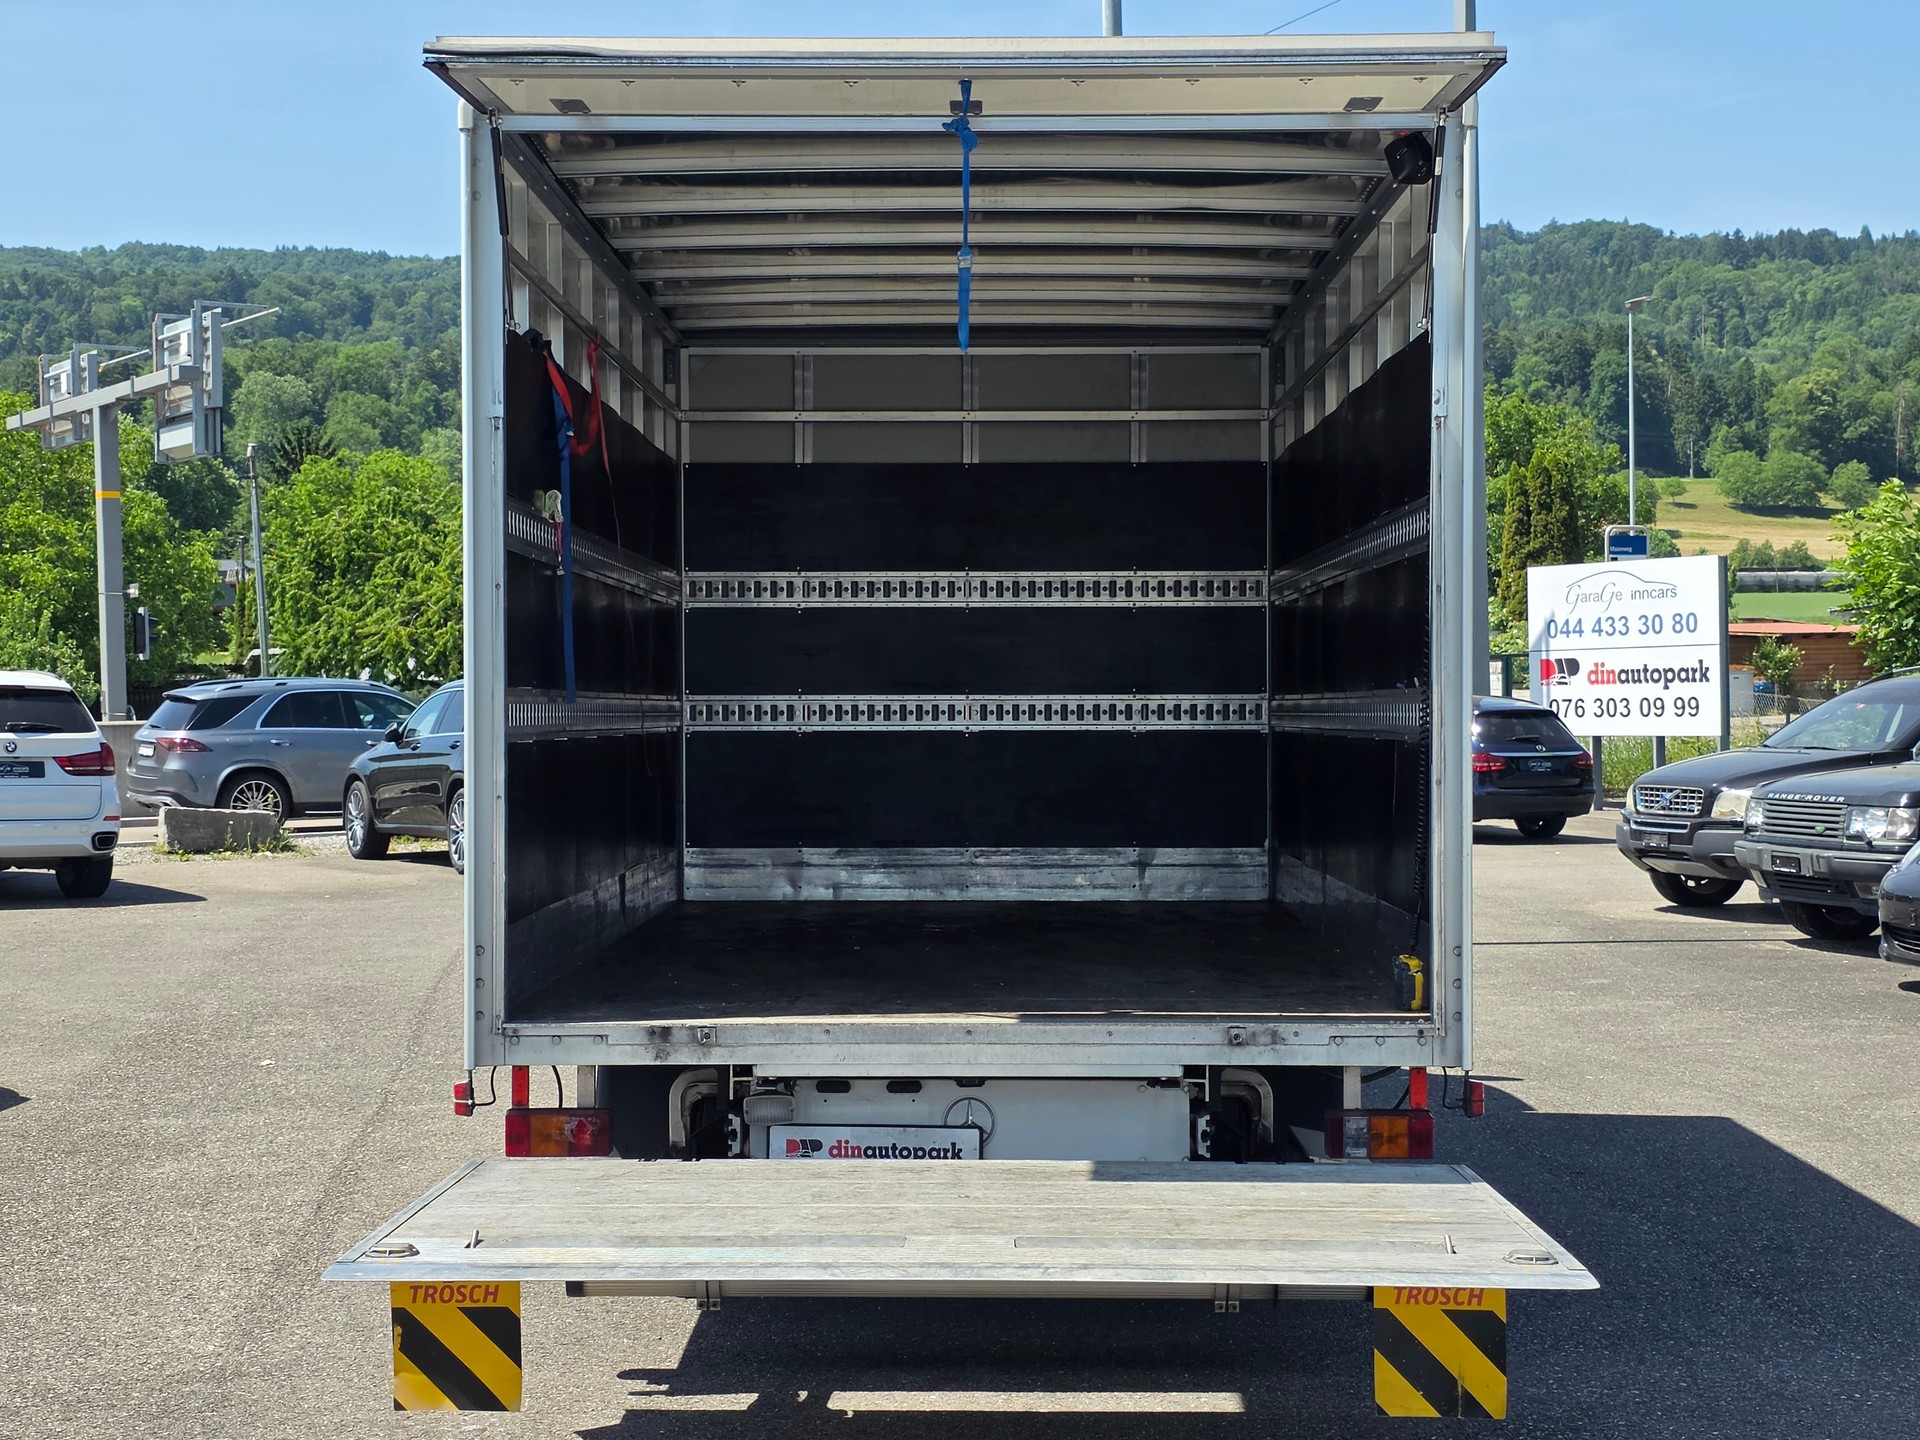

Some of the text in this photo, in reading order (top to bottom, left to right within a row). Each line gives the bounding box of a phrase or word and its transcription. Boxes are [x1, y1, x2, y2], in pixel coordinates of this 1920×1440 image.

[1565, 582, 1678, 615] GaraGe inncars
[1546, 612, 1698, 639] 044 433 30 80
[1586, 659, 1710, 690] dinautopark
[1549, 696, 1700, 718] 076 303 09 99
[1767, 792, 1846, 803] RANGE ROVER
[828, 1139, 963, 1160] dinautopark
